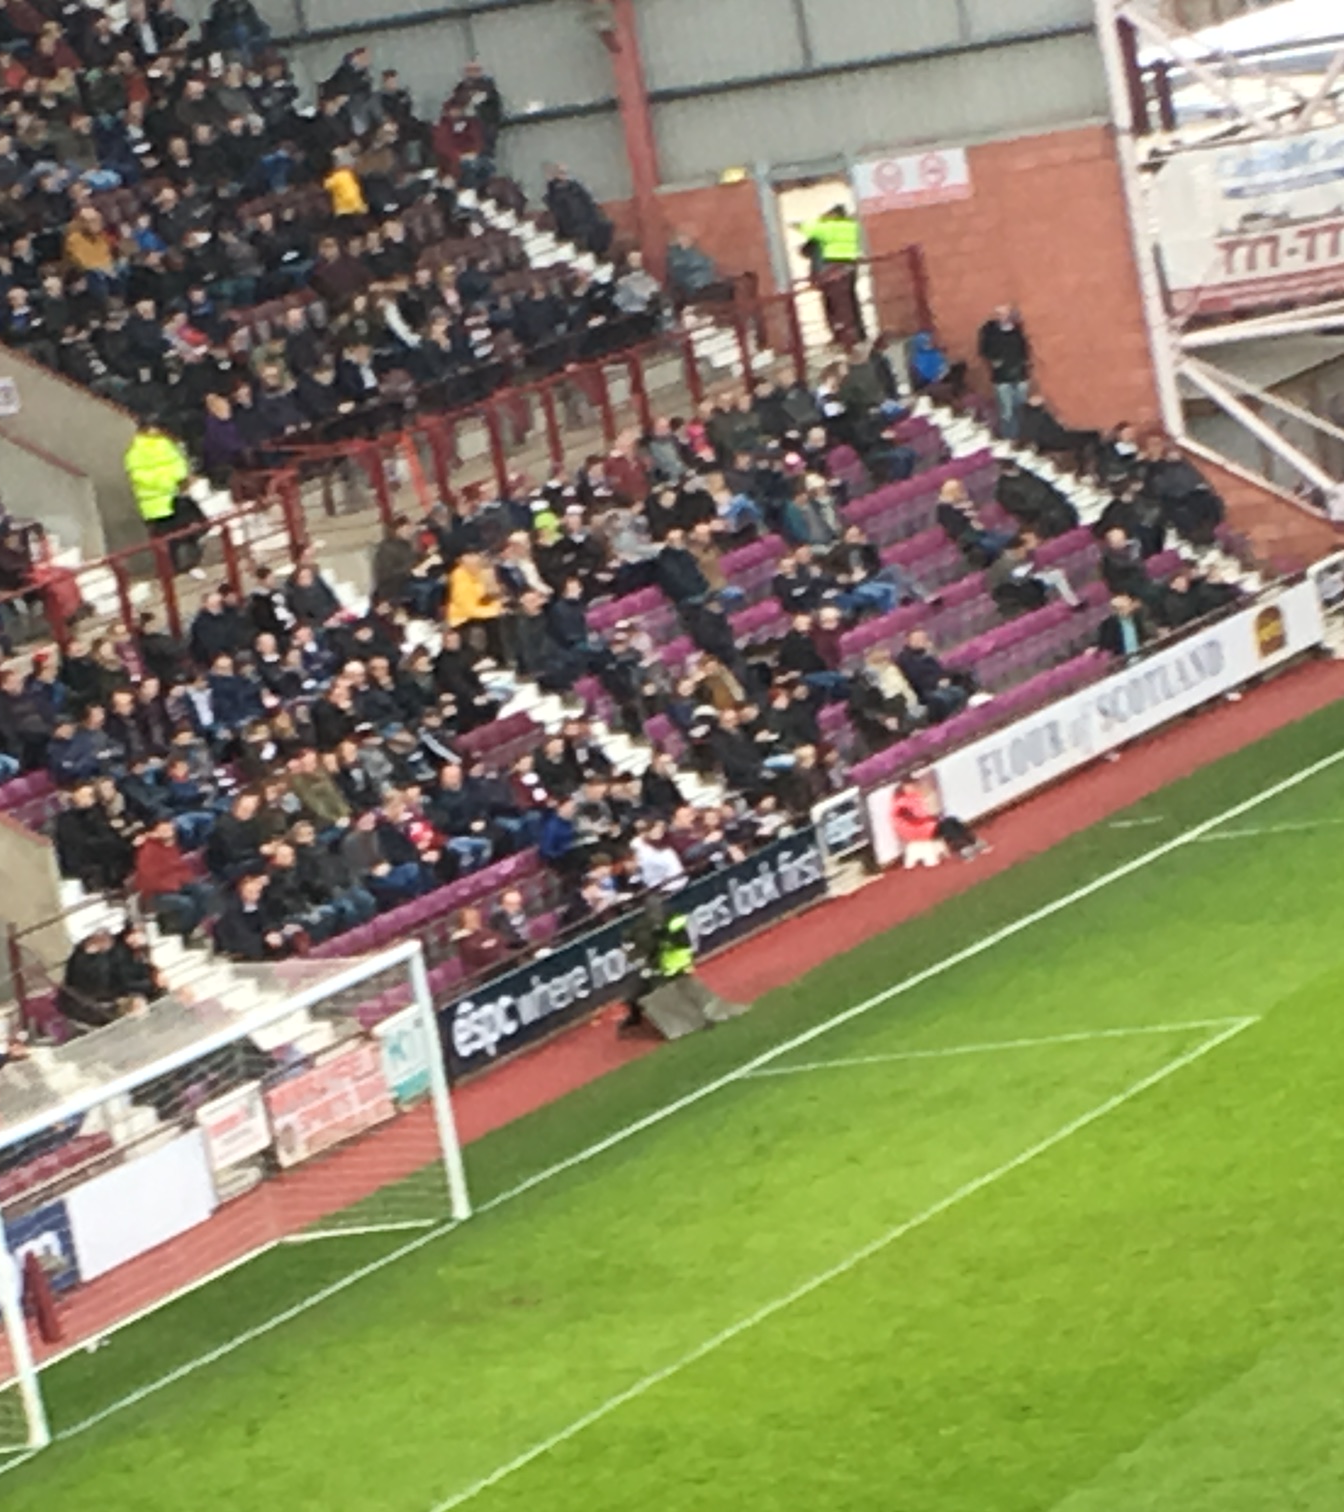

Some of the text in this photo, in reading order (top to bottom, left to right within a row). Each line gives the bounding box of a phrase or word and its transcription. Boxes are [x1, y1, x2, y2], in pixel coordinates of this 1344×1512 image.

[977, 720, 1061, 793] FLOUR
[1097, 640, 1226, 734] SCOTLAND
[517, 962, 590, 1026] where
[728, 862, 780, 917] look
[775, 846, 824, 894] first
